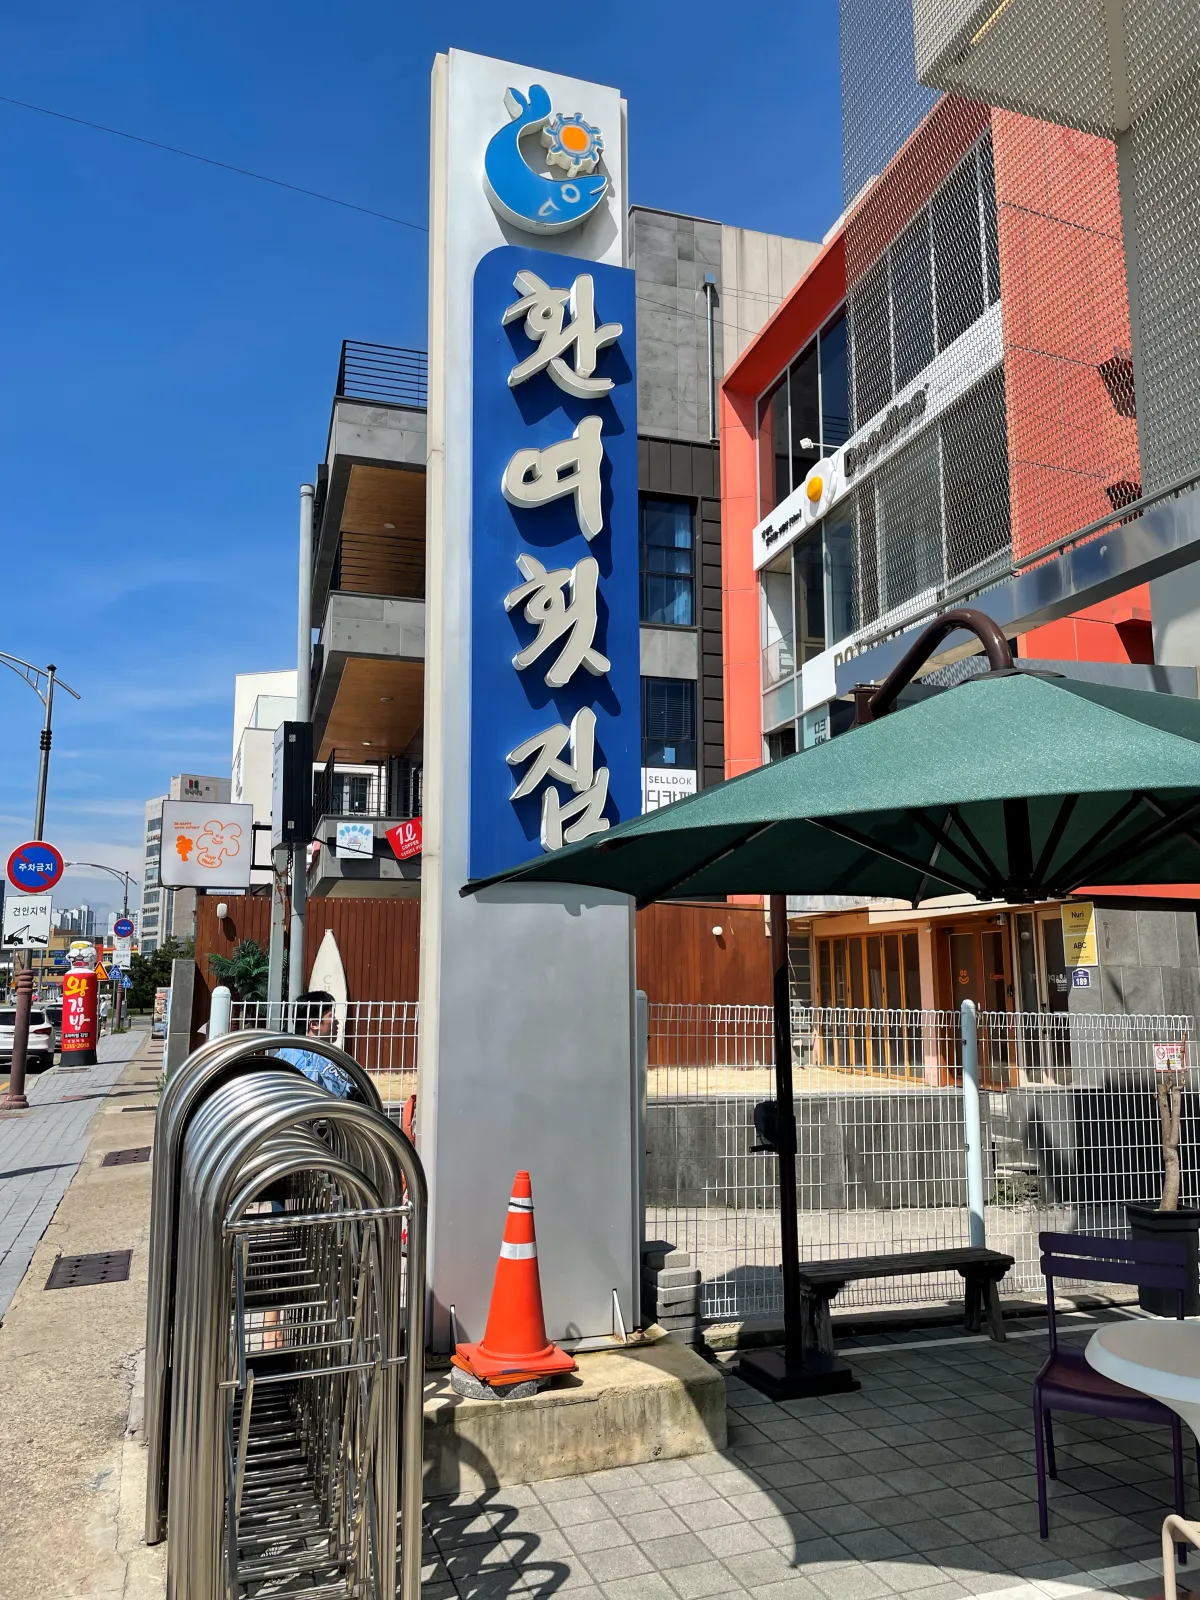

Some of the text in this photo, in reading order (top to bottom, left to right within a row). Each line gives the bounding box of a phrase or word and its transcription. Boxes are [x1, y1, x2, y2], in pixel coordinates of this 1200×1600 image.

[500, 269, 624, 853] 환여횟집
[648, 775, 692, 785] SELLDOK
[401, 840, 420, 850] COFFEE
[18, 862, 53, 872] 주차금지
[13, 906, 47, 916] 견인지역
[1071, 910, 1084, 919] Nuri
[1073, 942, 1087, 950] ABC
